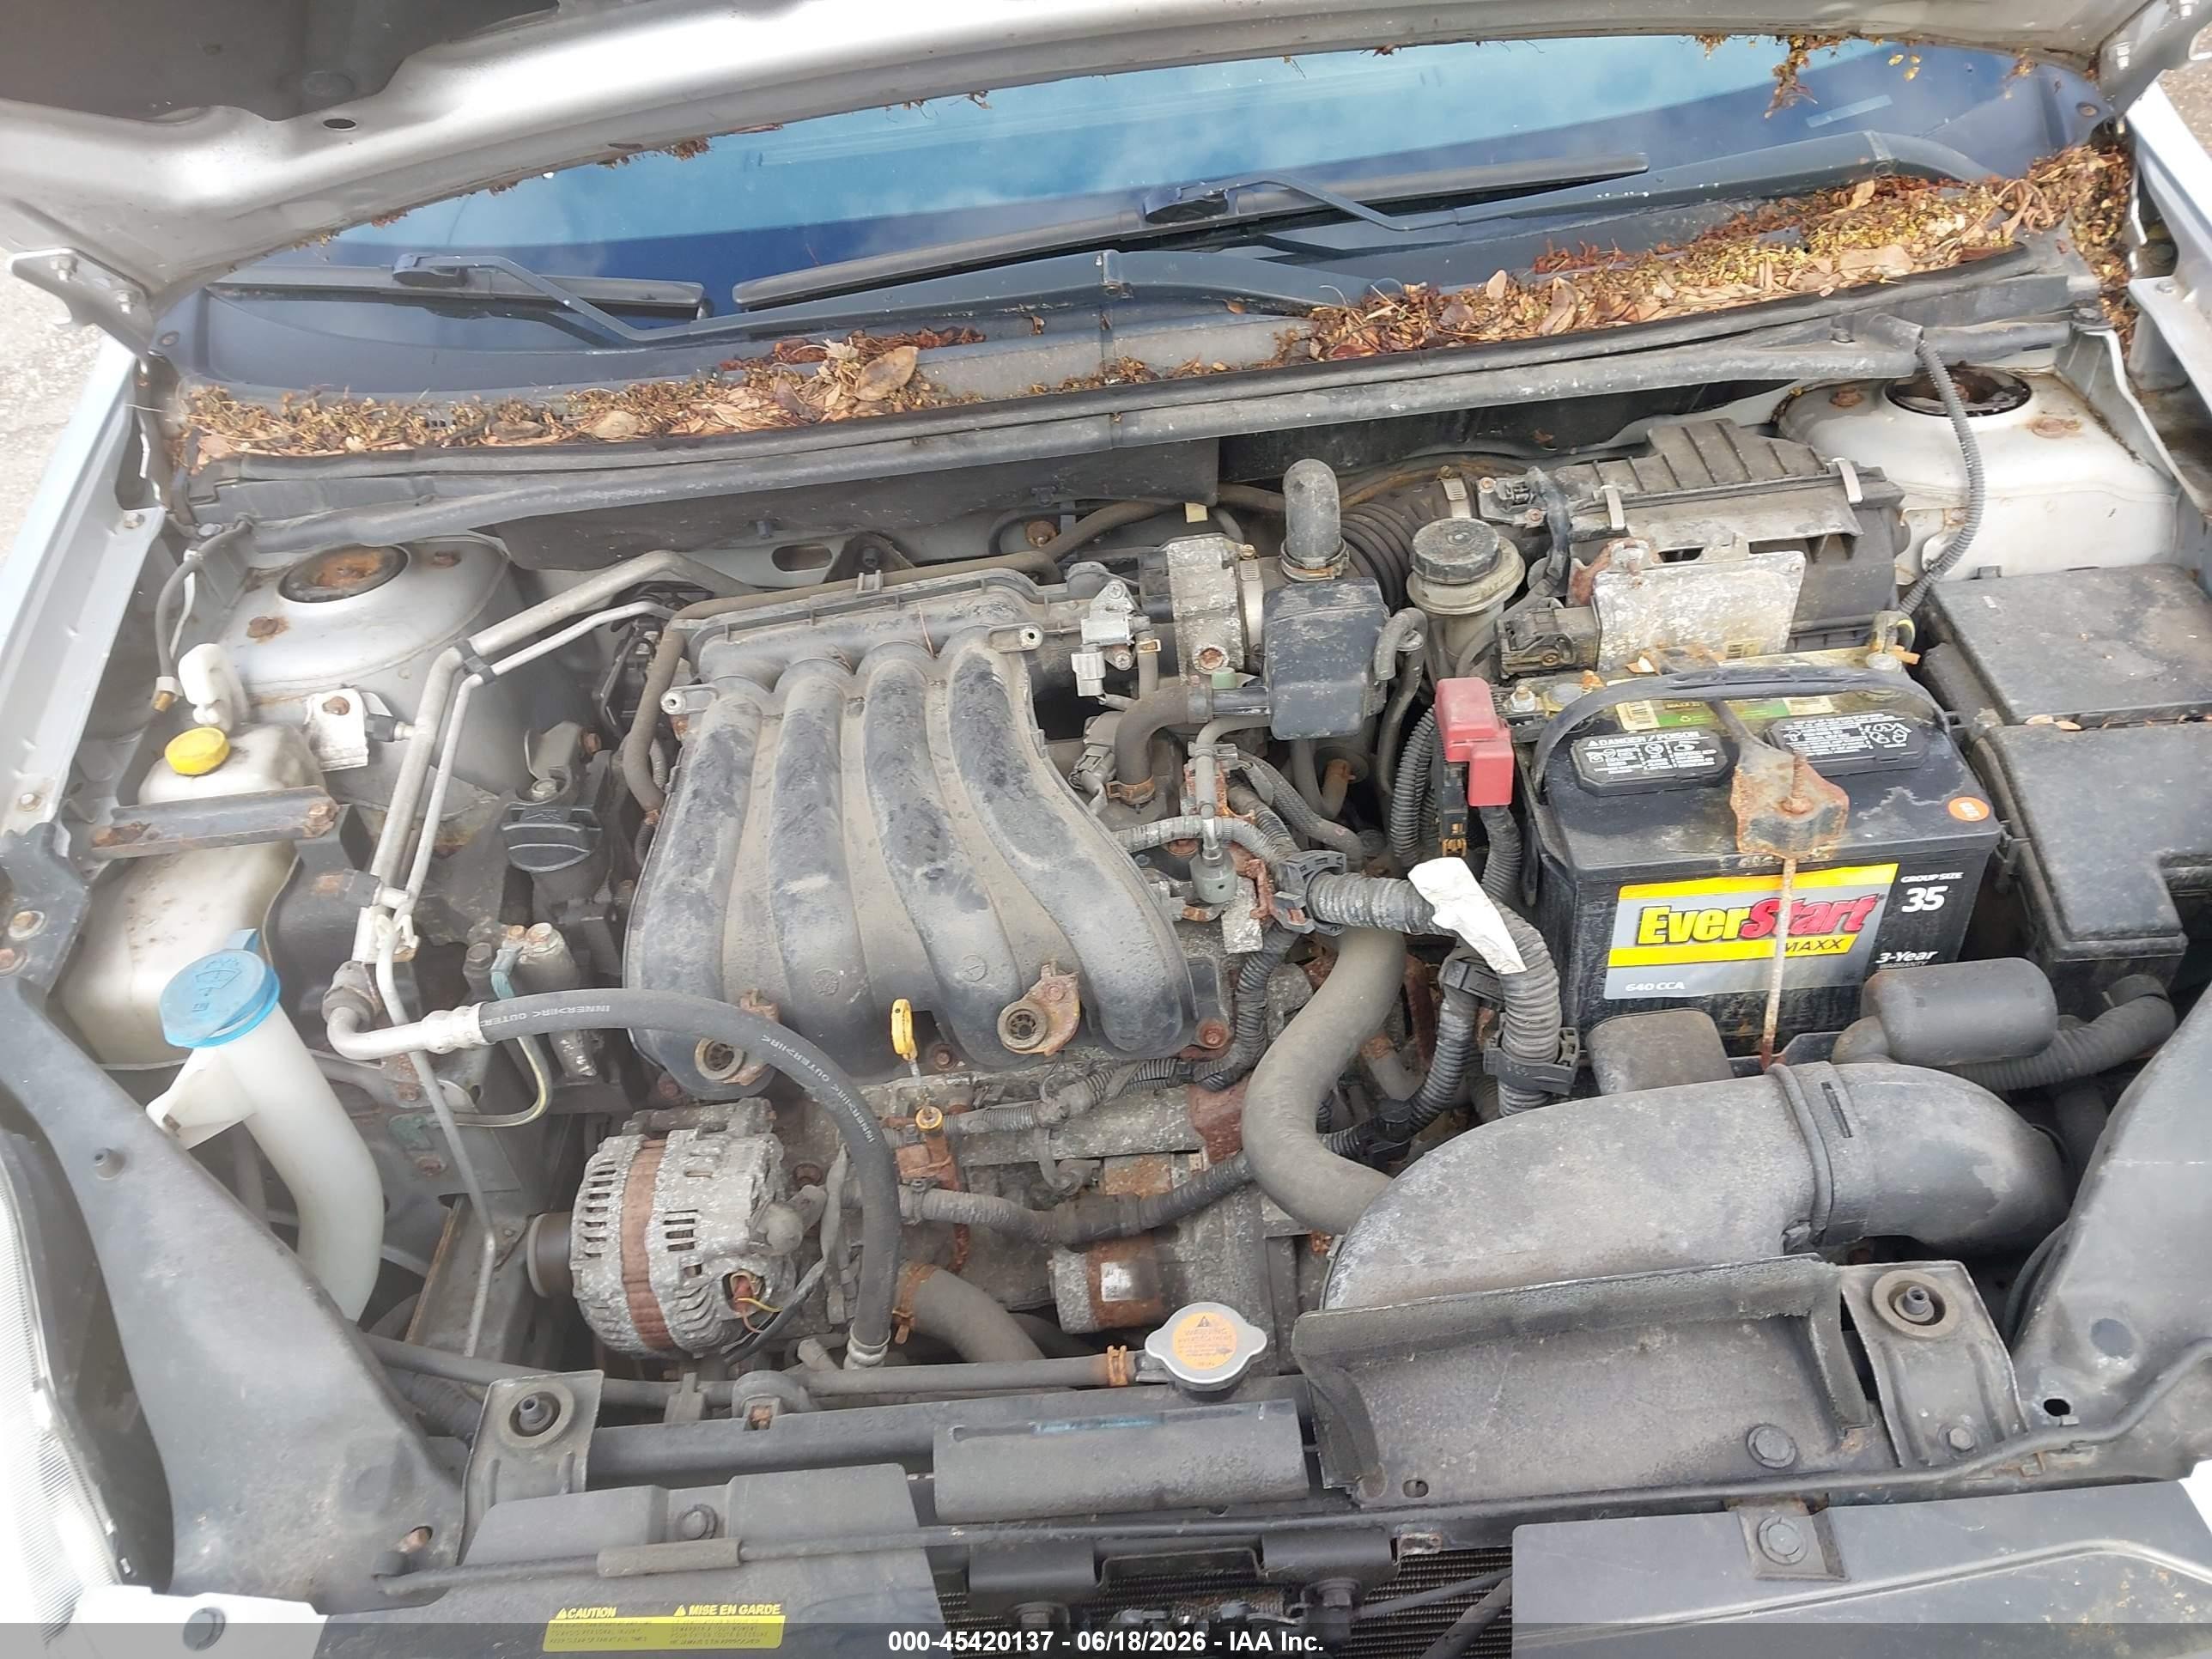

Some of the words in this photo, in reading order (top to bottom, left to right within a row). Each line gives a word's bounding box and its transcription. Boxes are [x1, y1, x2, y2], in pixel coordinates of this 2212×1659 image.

[1598, 736, 1647, 747] DANGER
[1657, 730, 1700, 741] POISON
[1899, 873, 1939, 884] GROUP
[1939, 872, 1965, 880] SIZE
[1900, 885, 1948, 913] 35
[1875, 951, 1939, 964] 3-Year
[1625, 982, 1655, 992] 640
[1656, 981, 1686, 990] CCA
[567, 1607, 617, 1619] CAUTION
[688, 1604, 719, 1616] MISE
[719, 1604, 738, 1616] EN
[738, 1603, 782, 1616] GARDE
